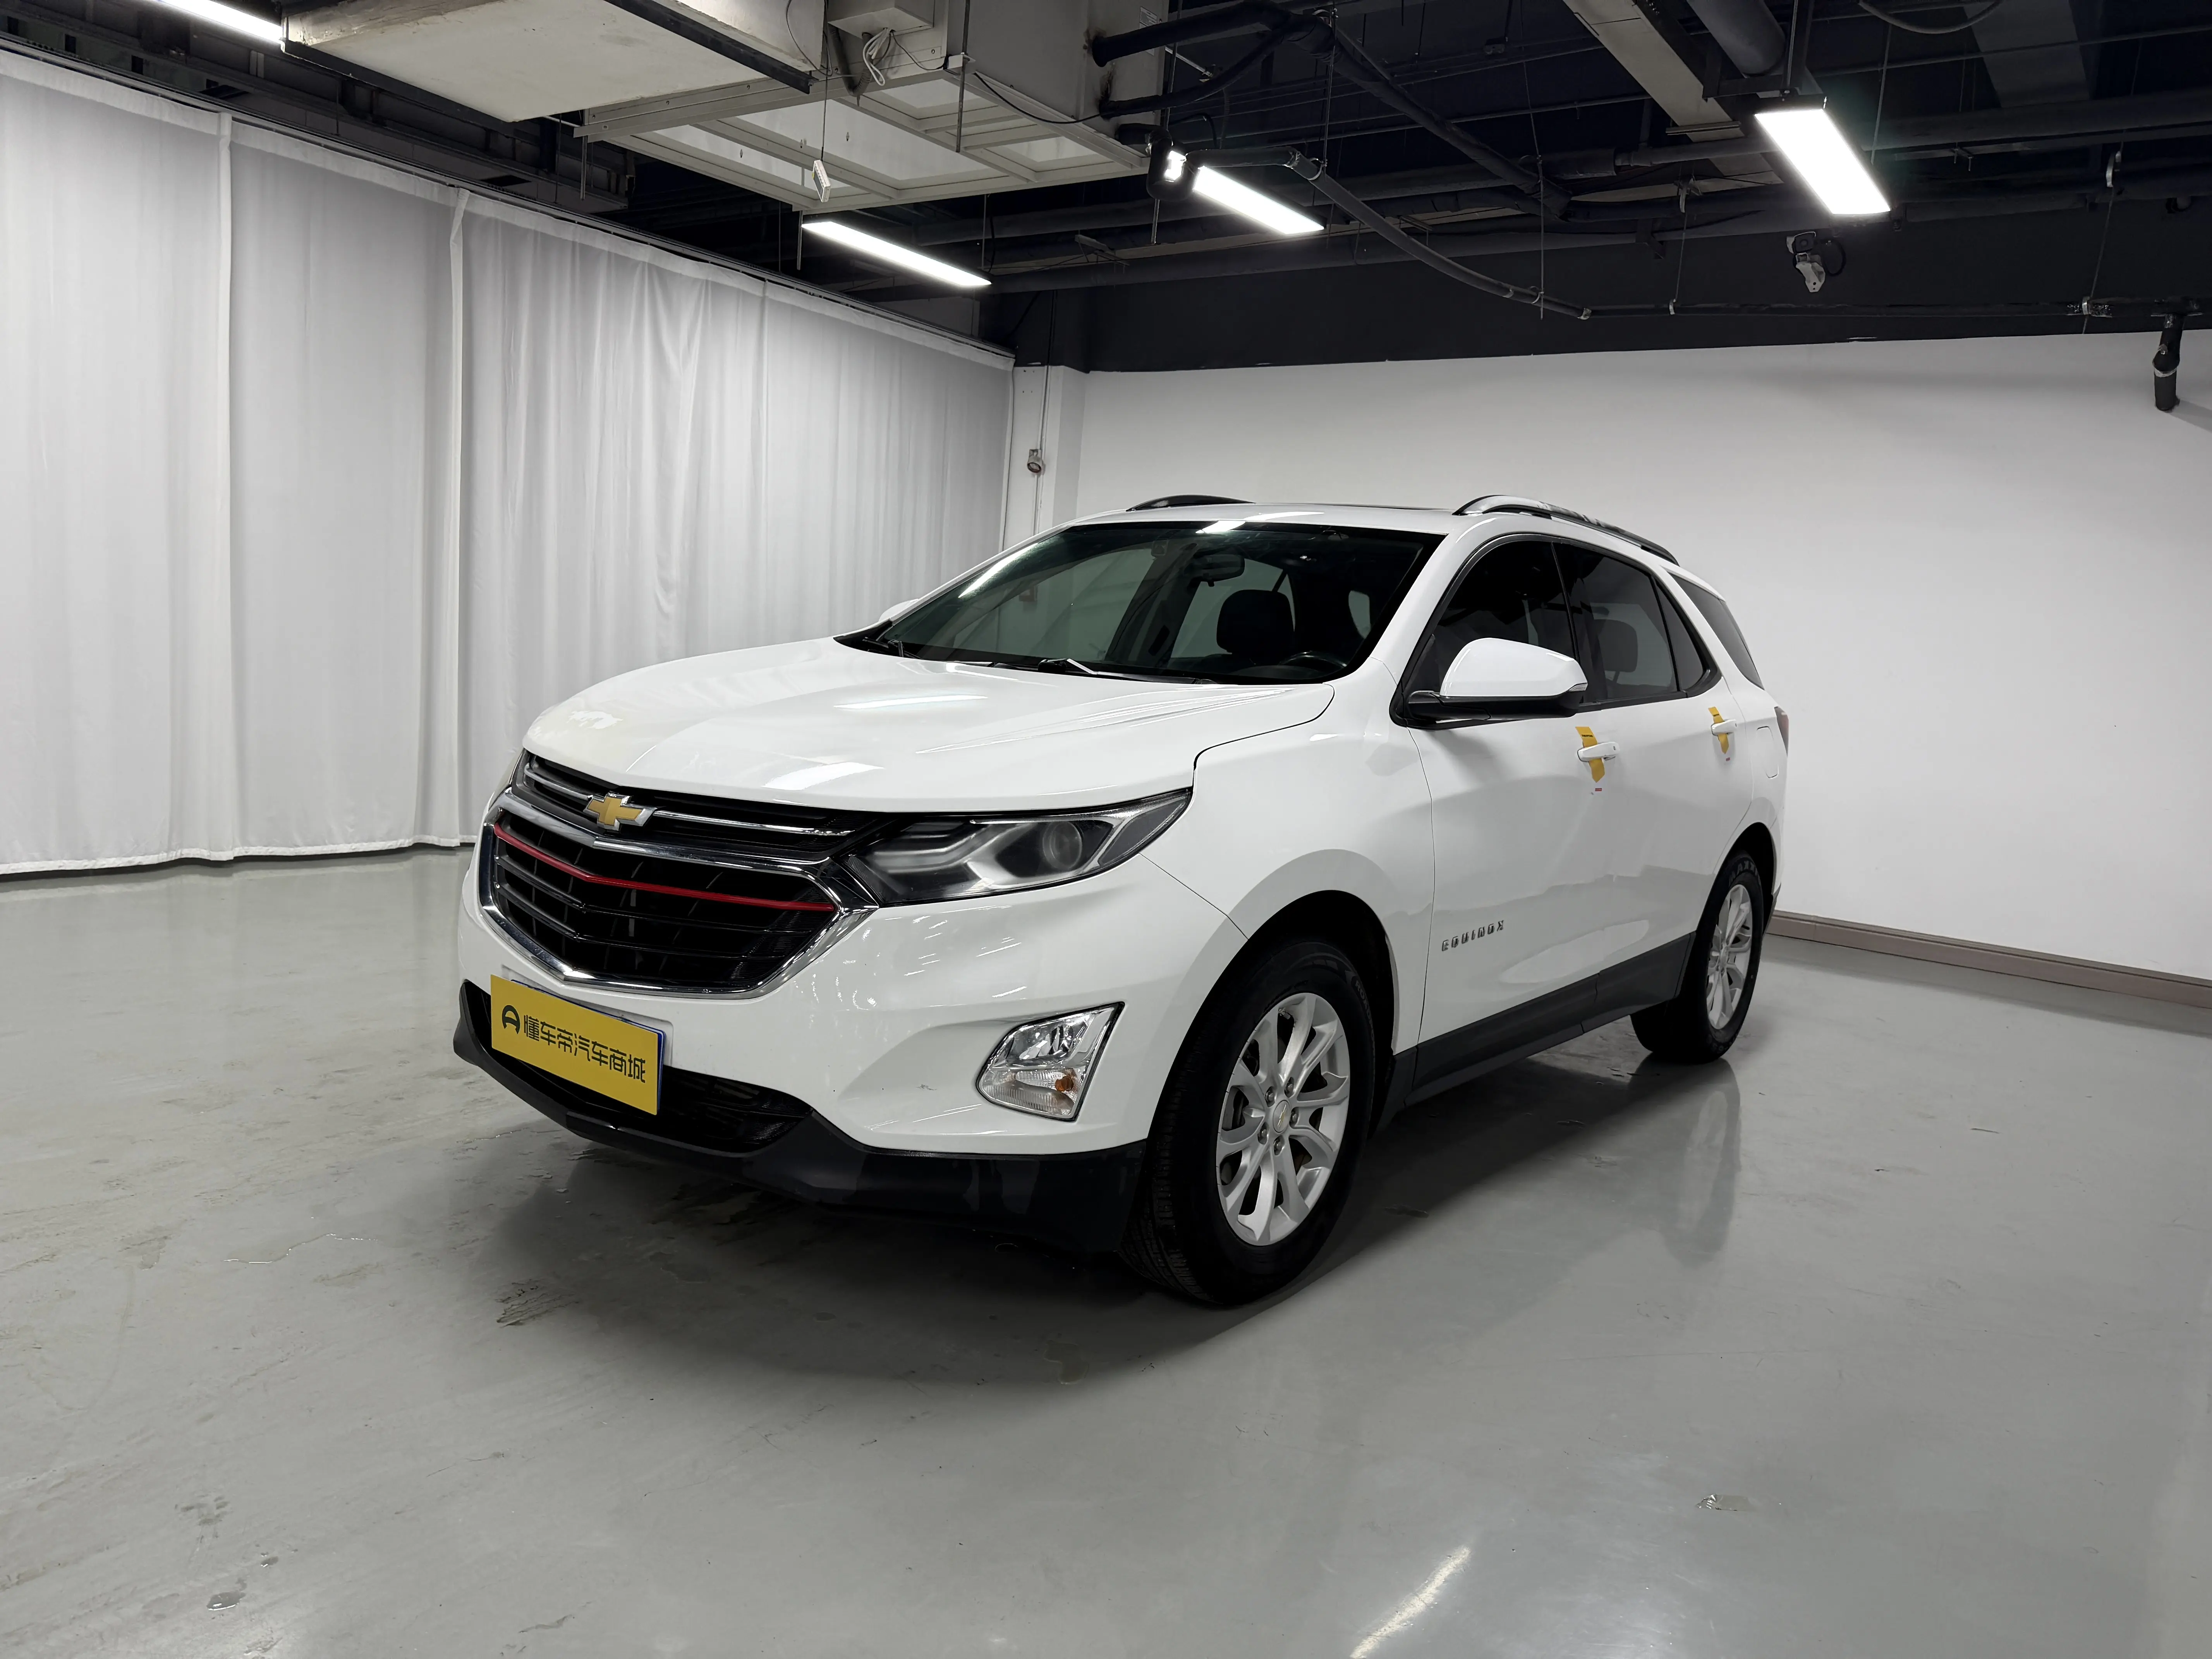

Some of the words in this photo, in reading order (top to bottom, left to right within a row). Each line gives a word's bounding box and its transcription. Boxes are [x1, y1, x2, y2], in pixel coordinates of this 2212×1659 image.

[1441, 920, 1504, 951] EQUINOX
[524, 1015, 646, 1083] 懂车帝汽车商城
